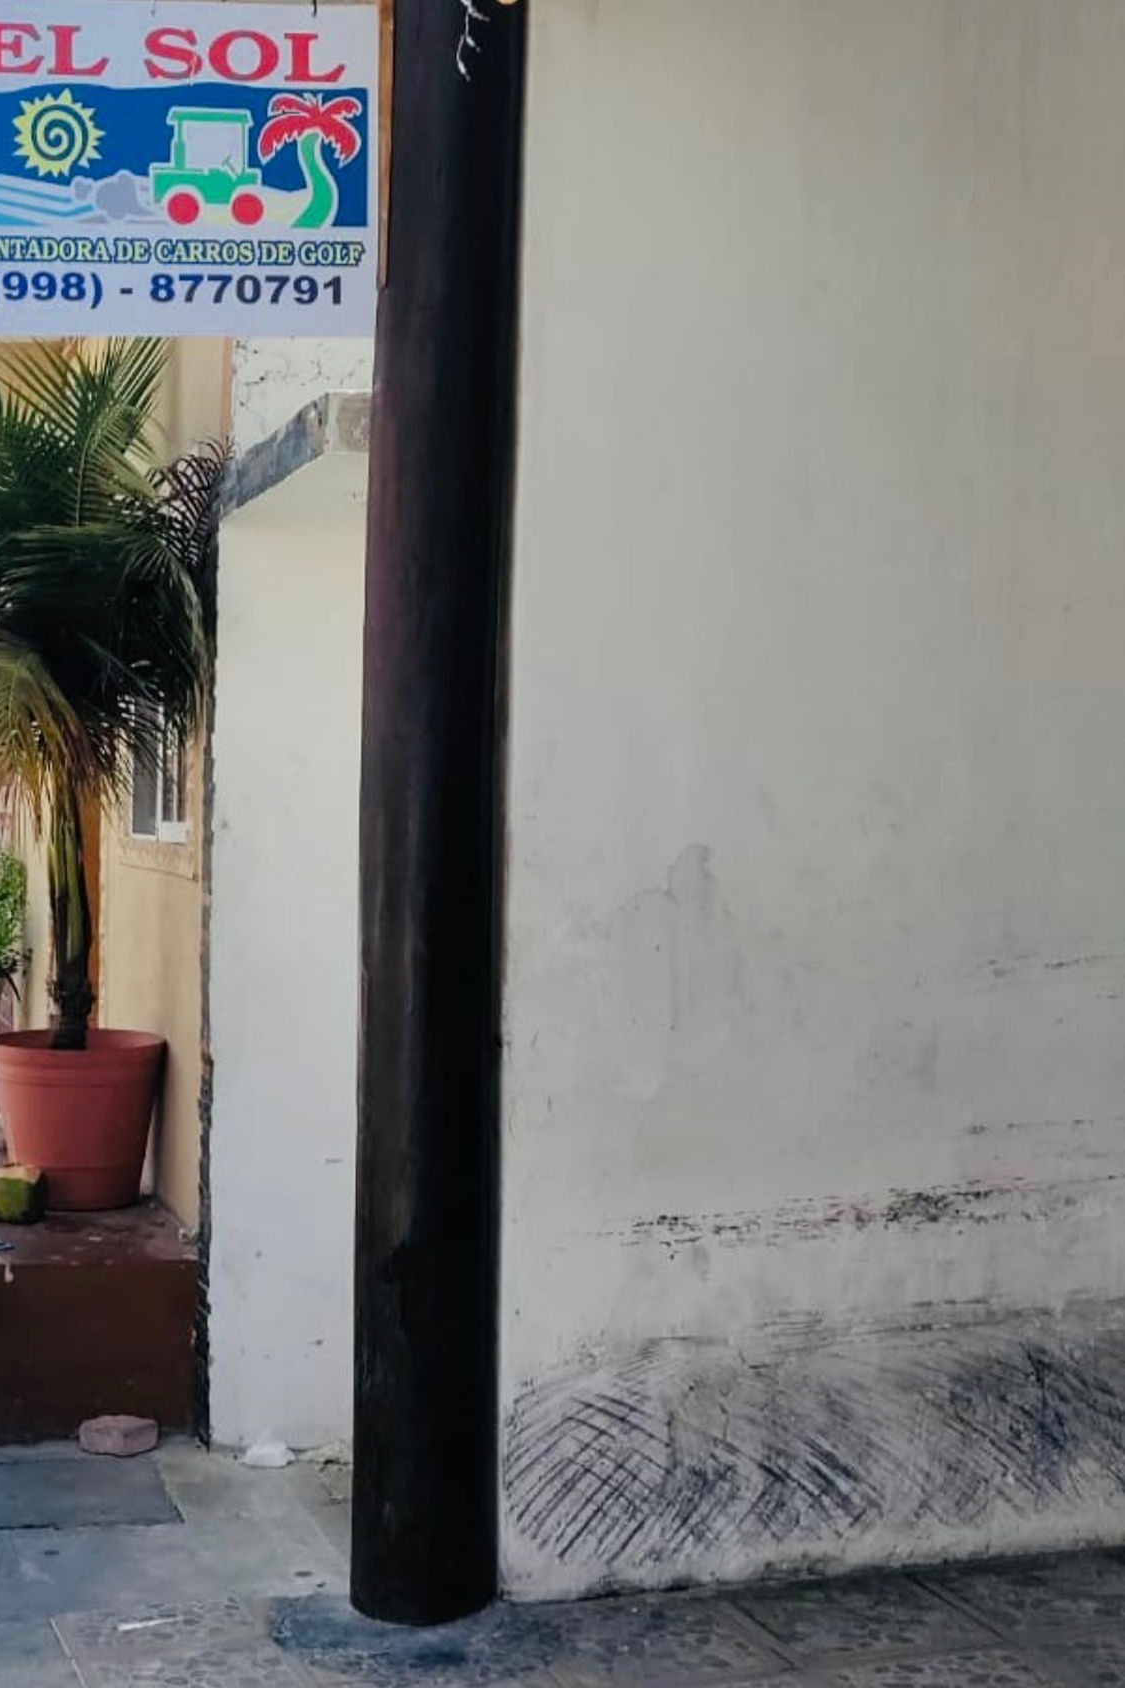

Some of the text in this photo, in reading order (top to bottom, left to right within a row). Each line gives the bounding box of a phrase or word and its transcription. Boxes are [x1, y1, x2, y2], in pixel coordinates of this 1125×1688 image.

[143, 27, 346, 83] SOL
[114, 238, 152, 264] DE
[154, 238, 254, 265] CARROS
[257, 240, 295, 266] DE
[298, 240, 365, 267] GOLF
[149, 273, 342, 306] 8770791
